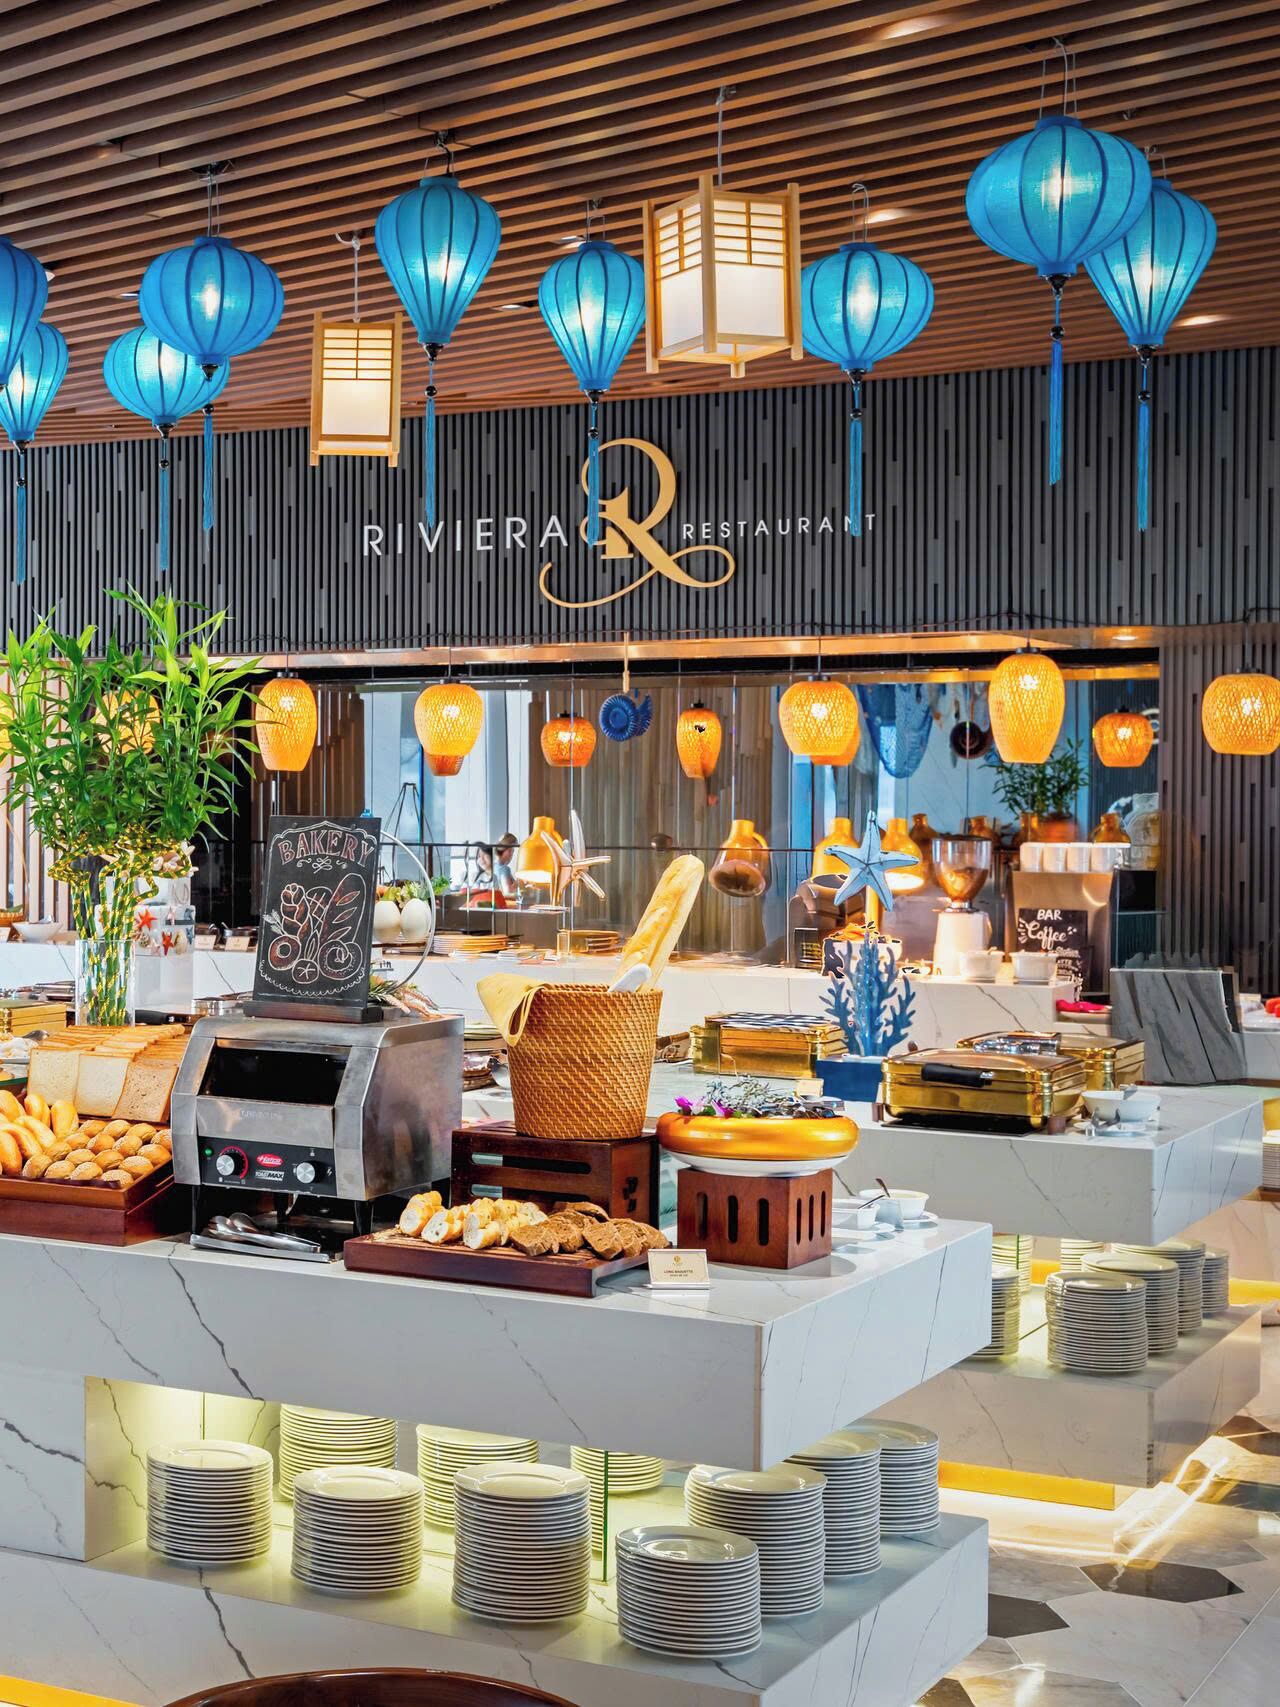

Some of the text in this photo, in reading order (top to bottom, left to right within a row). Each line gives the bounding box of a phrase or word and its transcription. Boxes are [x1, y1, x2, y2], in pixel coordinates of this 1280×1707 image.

[363, 515, 569, 556] RIVIERA
[277, 829, 375, 868] BAKERY
[1036, 909, 1062, 920] BAR
[1026, 920, 1068, 950] Coffee
